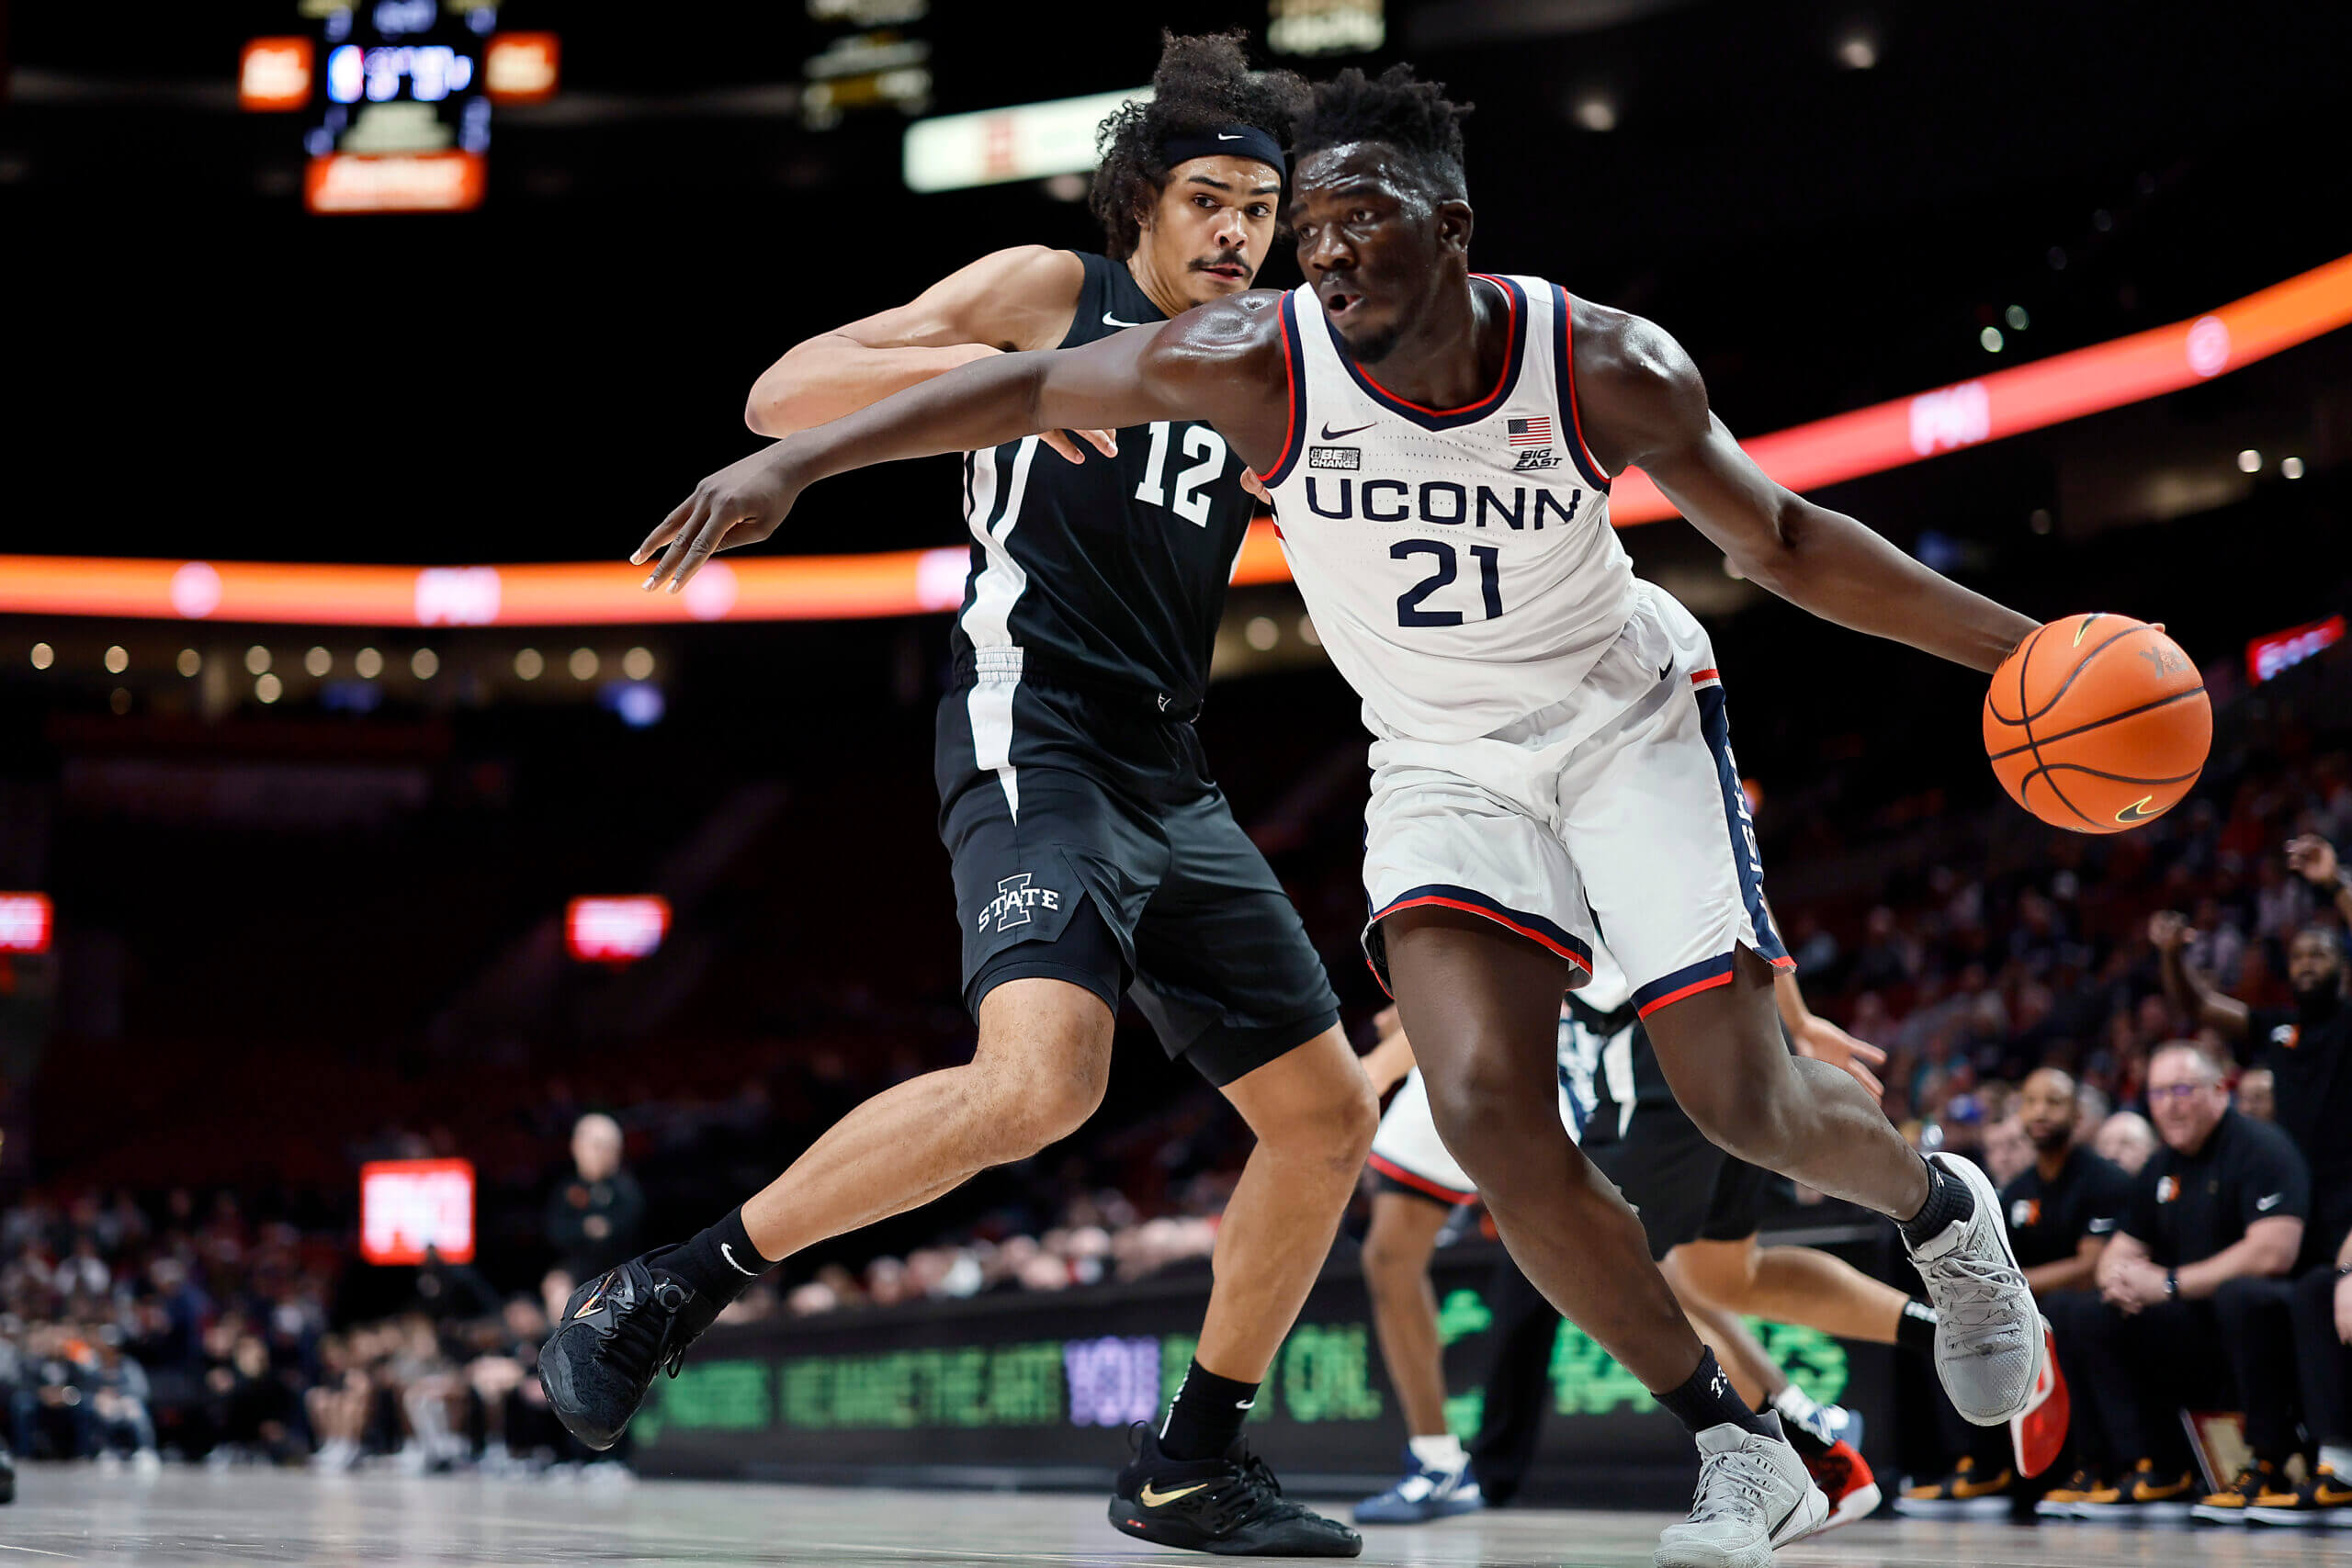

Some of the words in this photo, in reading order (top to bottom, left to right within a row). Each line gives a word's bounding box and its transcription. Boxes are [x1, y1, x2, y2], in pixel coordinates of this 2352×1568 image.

[1135, 421, 1227, 528] 12
[1311, 459, 1358, 468] CHANGE
[1516, 457, 1563, 468] EAST
[1520, 448, 1552, 459] BIG
[1306, 476, 1581, 531] UCONN
[1389, 538, 1503, 627] 21
[978, 888, 1059, 934] STATE
